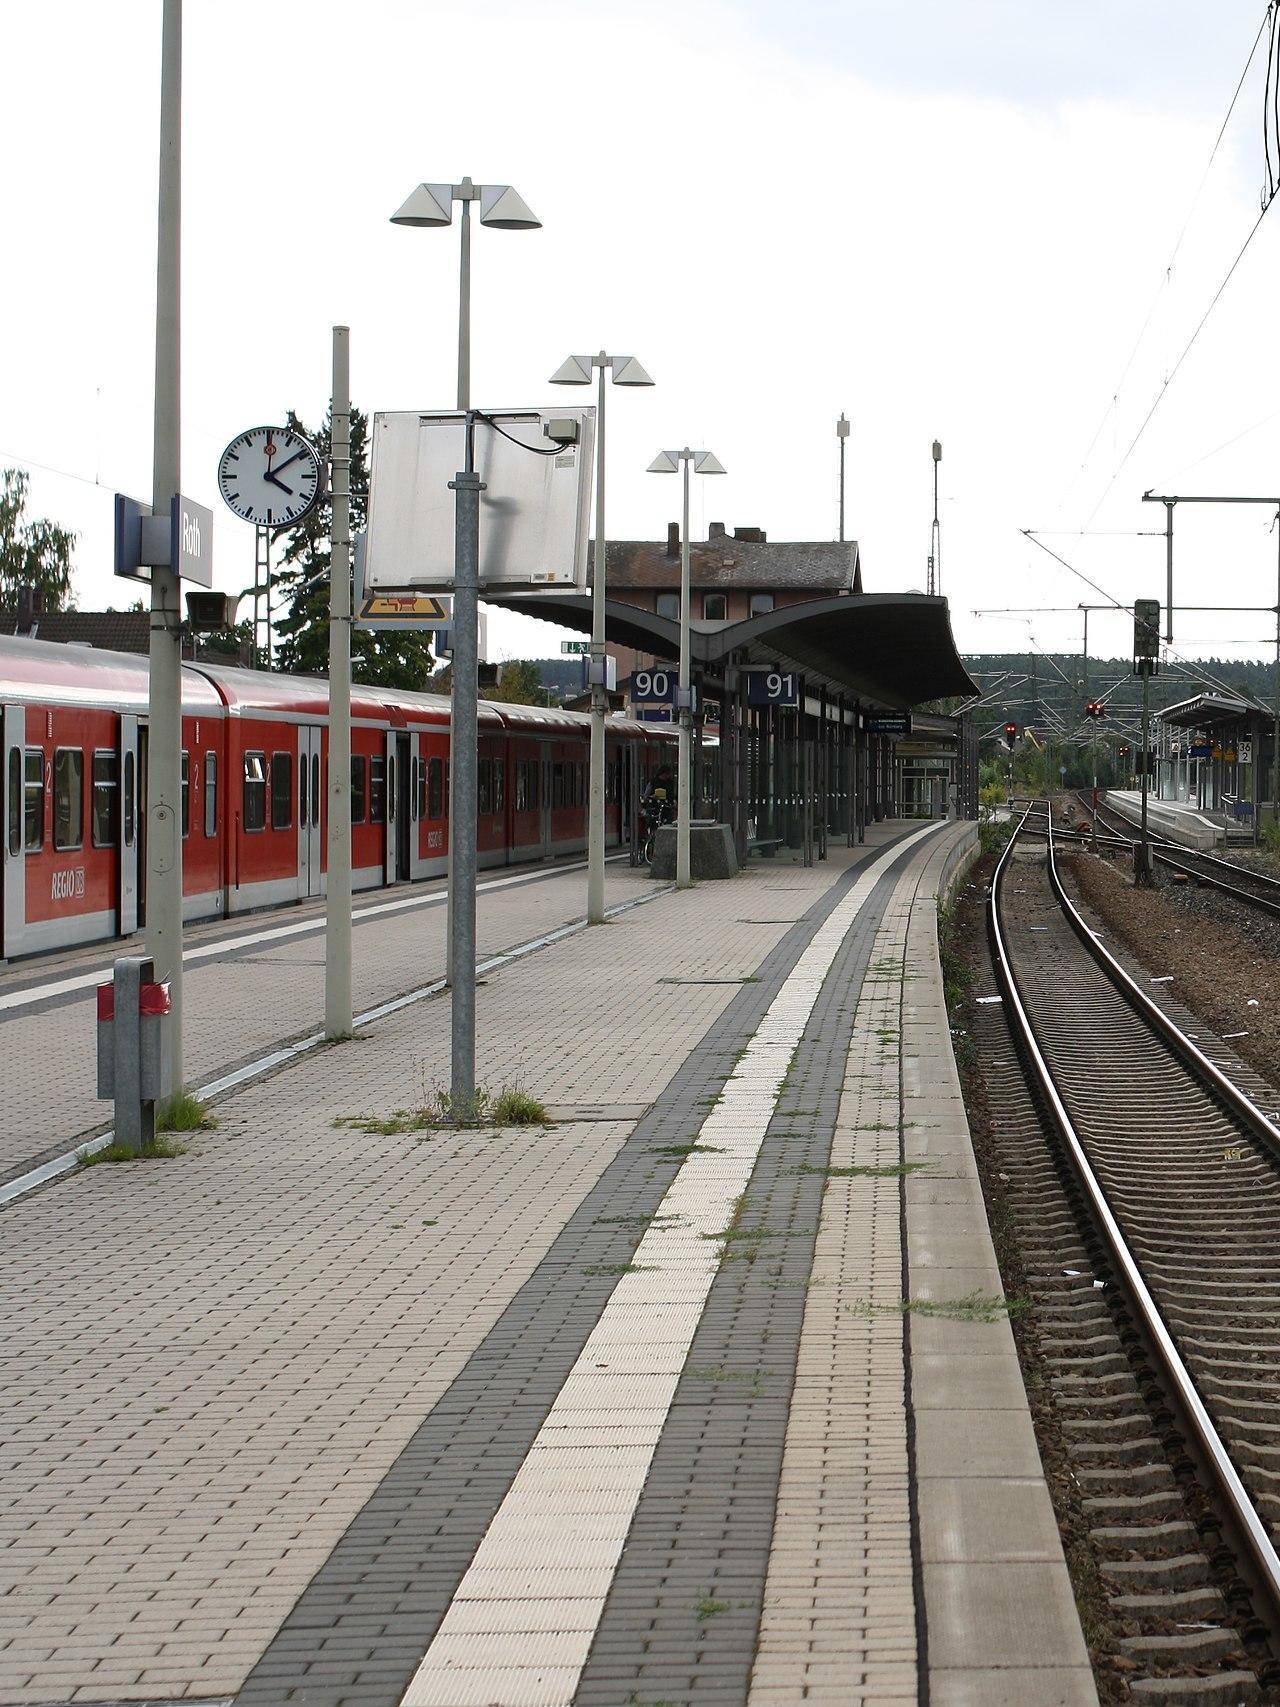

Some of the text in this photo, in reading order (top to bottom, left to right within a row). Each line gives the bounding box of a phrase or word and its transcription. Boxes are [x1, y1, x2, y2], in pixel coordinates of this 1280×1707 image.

[182, 511, 201, 558] Roth
[635, 672, 669, 697] 90
[766, 673, 793, 698] 91
[1239, 742, 1251, 752] 36
[1242, 752, 1248, 761] 2
[46, 761, 52, 794] 2
[194, 763, 199, 790] 2
[51, 870, 75, 900] REGIO
